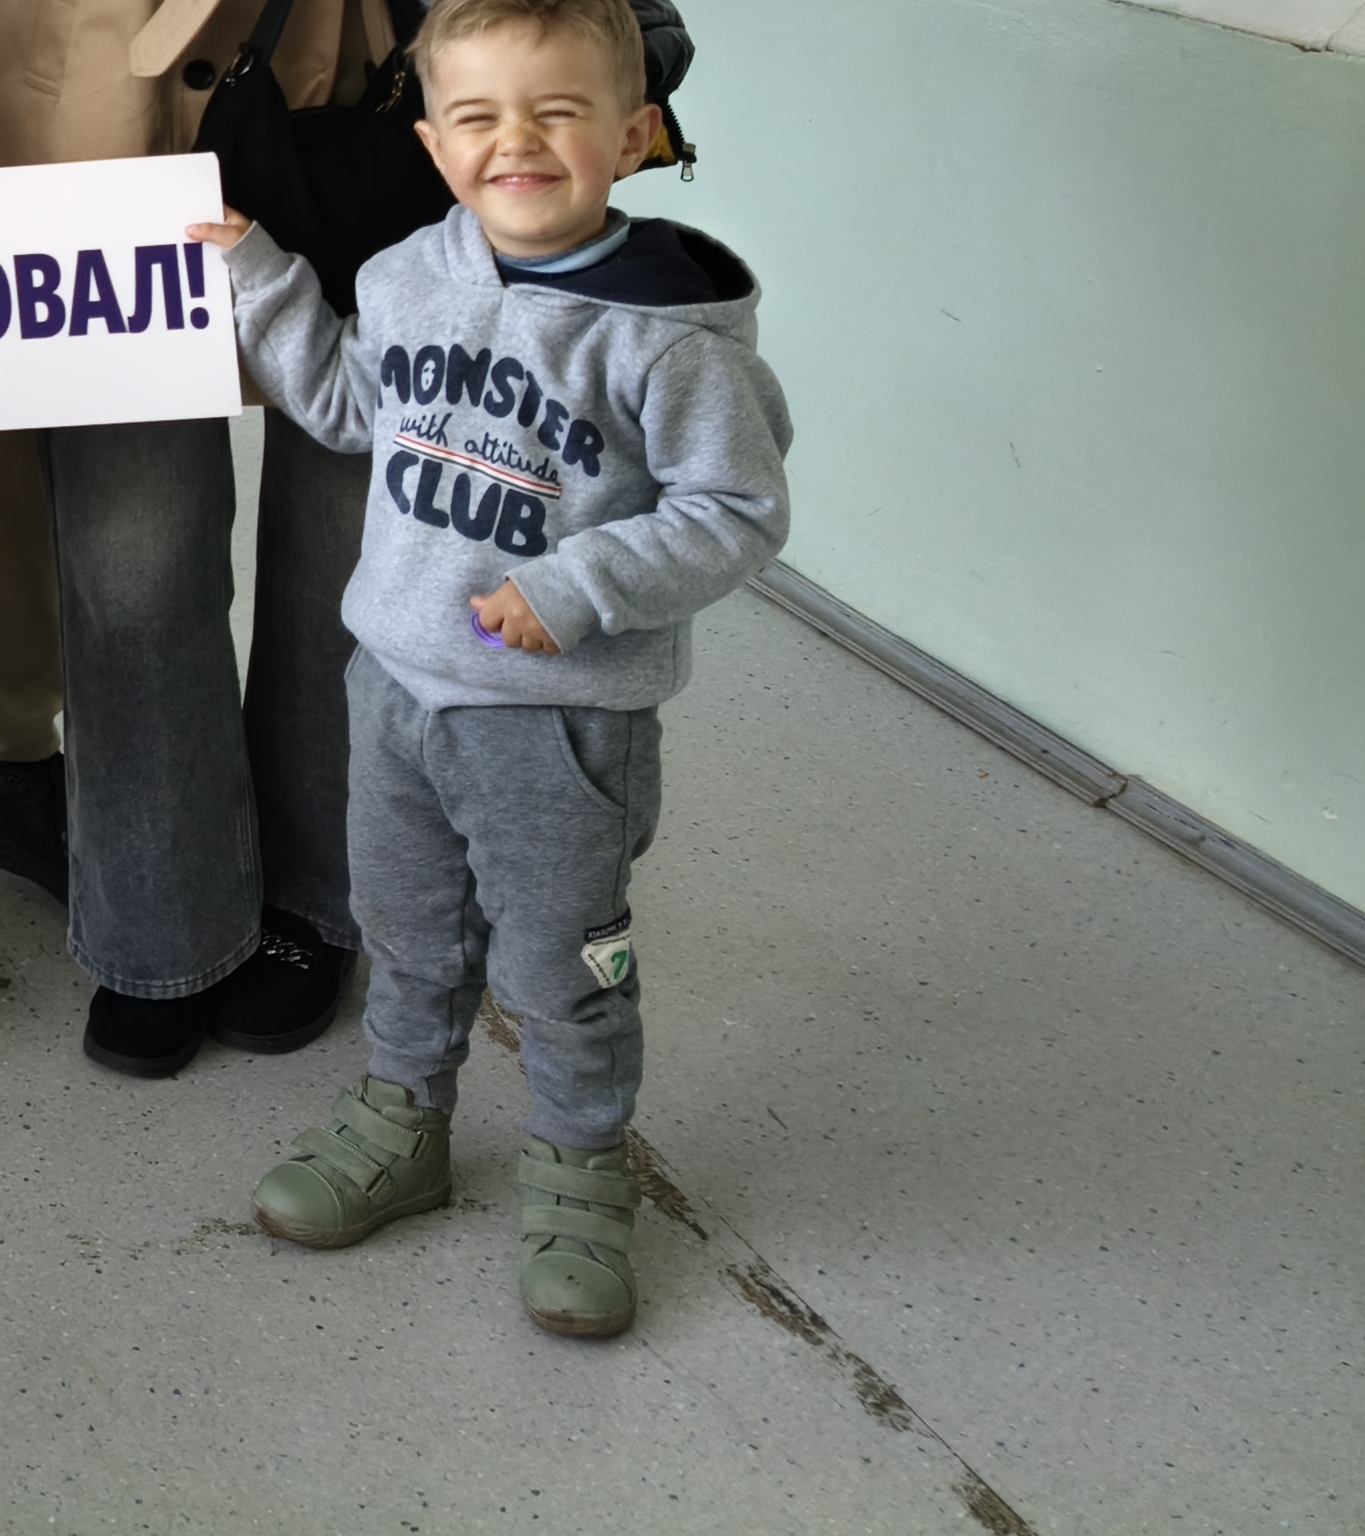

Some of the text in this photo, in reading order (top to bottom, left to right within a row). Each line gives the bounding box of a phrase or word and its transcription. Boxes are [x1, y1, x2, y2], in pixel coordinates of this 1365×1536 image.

[377, 343, 605, 478] MONSTER
[400, 412, 561, 485] with attitude
[385, 449, 548, 557] CLUB
